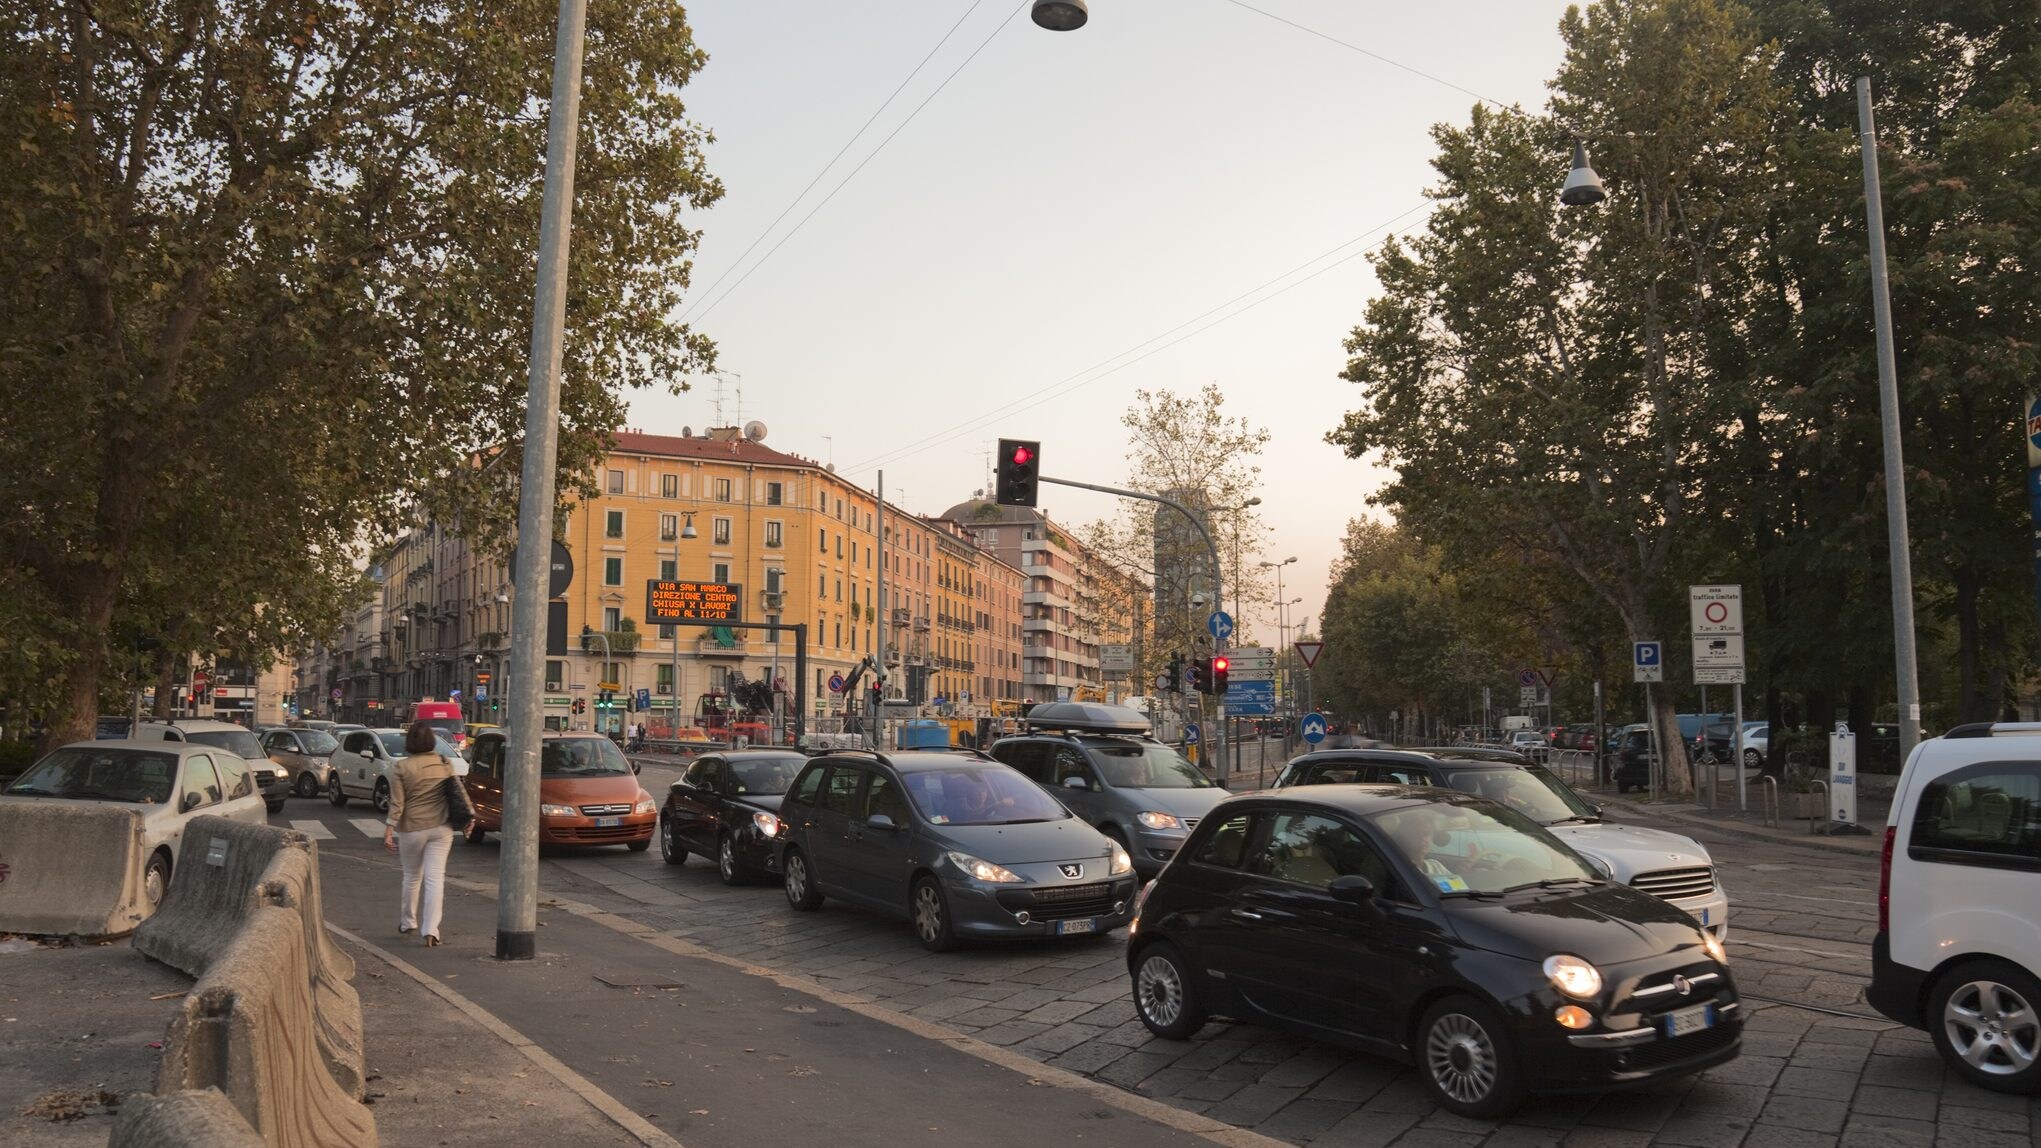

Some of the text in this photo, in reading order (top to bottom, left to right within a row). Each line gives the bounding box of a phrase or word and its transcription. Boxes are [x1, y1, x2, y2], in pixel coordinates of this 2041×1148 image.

[658, 582, 727, 593] VIA SAN MARCO
[653, 591, 736, 602] DIREZIONE CENTRO
[652, 600, 685, 608] CHIUSA
[700, 602, 731, 610] LAVORI
[657, 608, 727, 618] FINO AL 11/10
[1641, 646, 1654, 662] P
[640, 690, 647, 700] P
